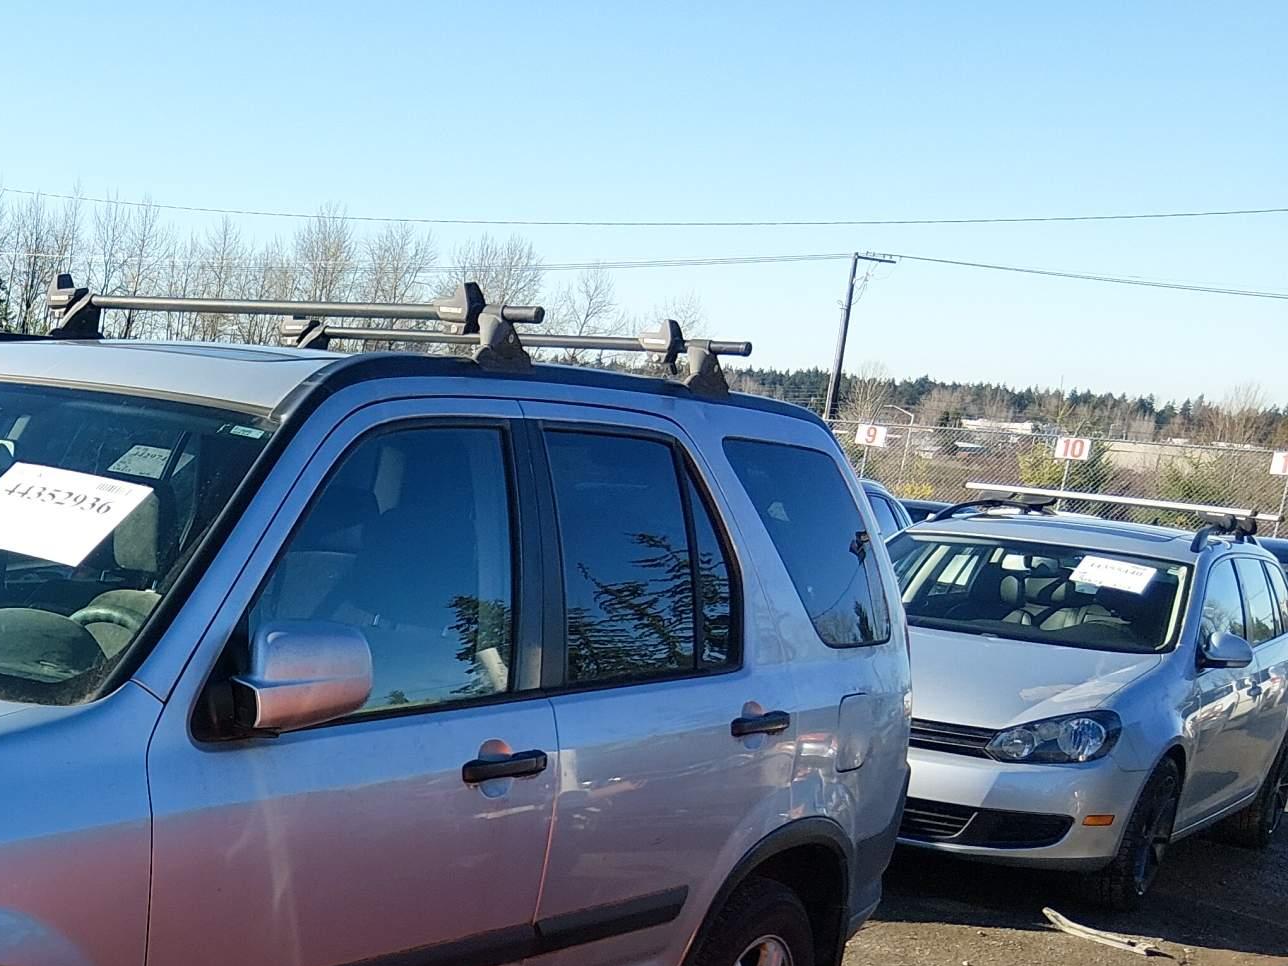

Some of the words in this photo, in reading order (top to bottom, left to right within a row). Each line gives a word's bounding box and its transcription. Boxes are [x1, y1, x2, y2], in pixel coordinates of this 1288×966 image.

[865, 426, 877, 443] 9
[1063, 439, 1084, 458] 10
[4, 482, 113, 515] 44352936
